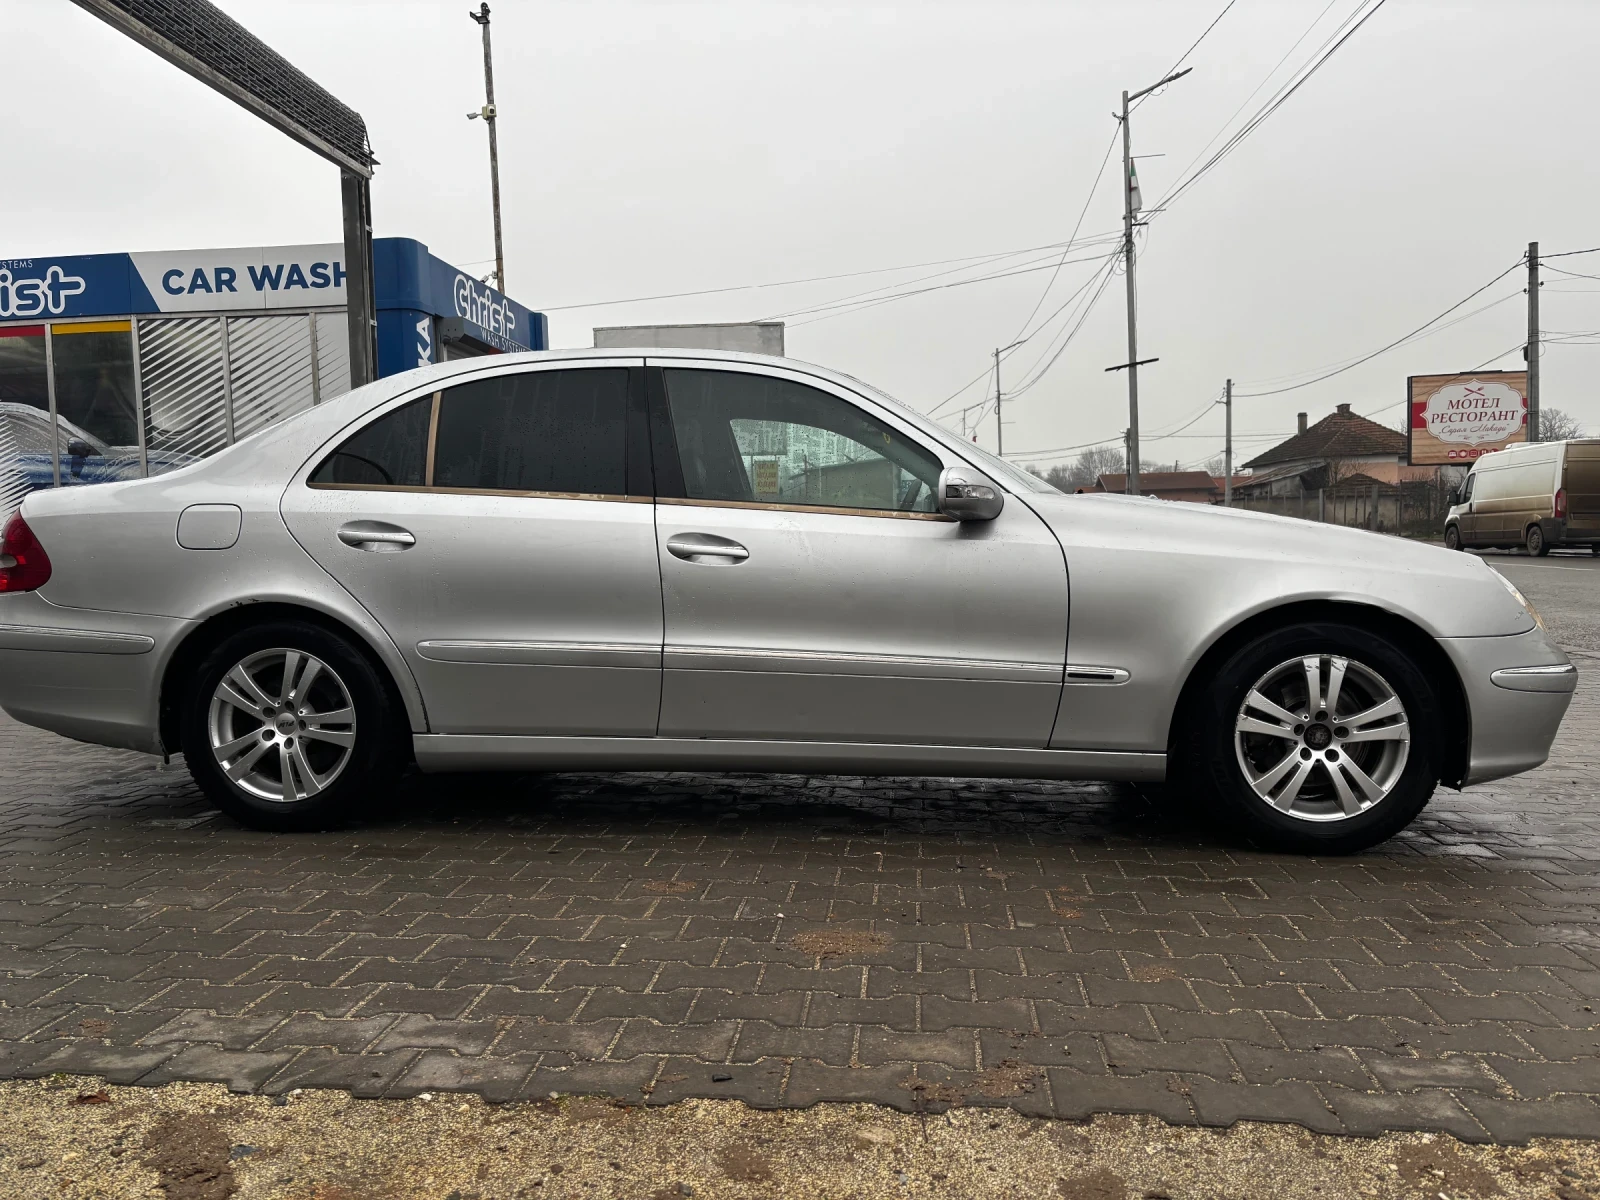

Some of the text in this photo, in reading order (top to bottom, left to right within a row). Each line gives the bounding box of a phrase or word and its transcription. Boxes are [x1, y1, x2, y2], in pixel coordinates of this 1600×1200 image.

[0, 260, 33, 269] STEMS
[162, 262, 346, 295] CAR WASH
[454, 274, 515, 339] Christ
[480, 327, 500, 348] WASH
[1446, 397, 1501, 410] МОТЕЛ
[1431, 410, 1519, 424] РЕСТОРАНТ
